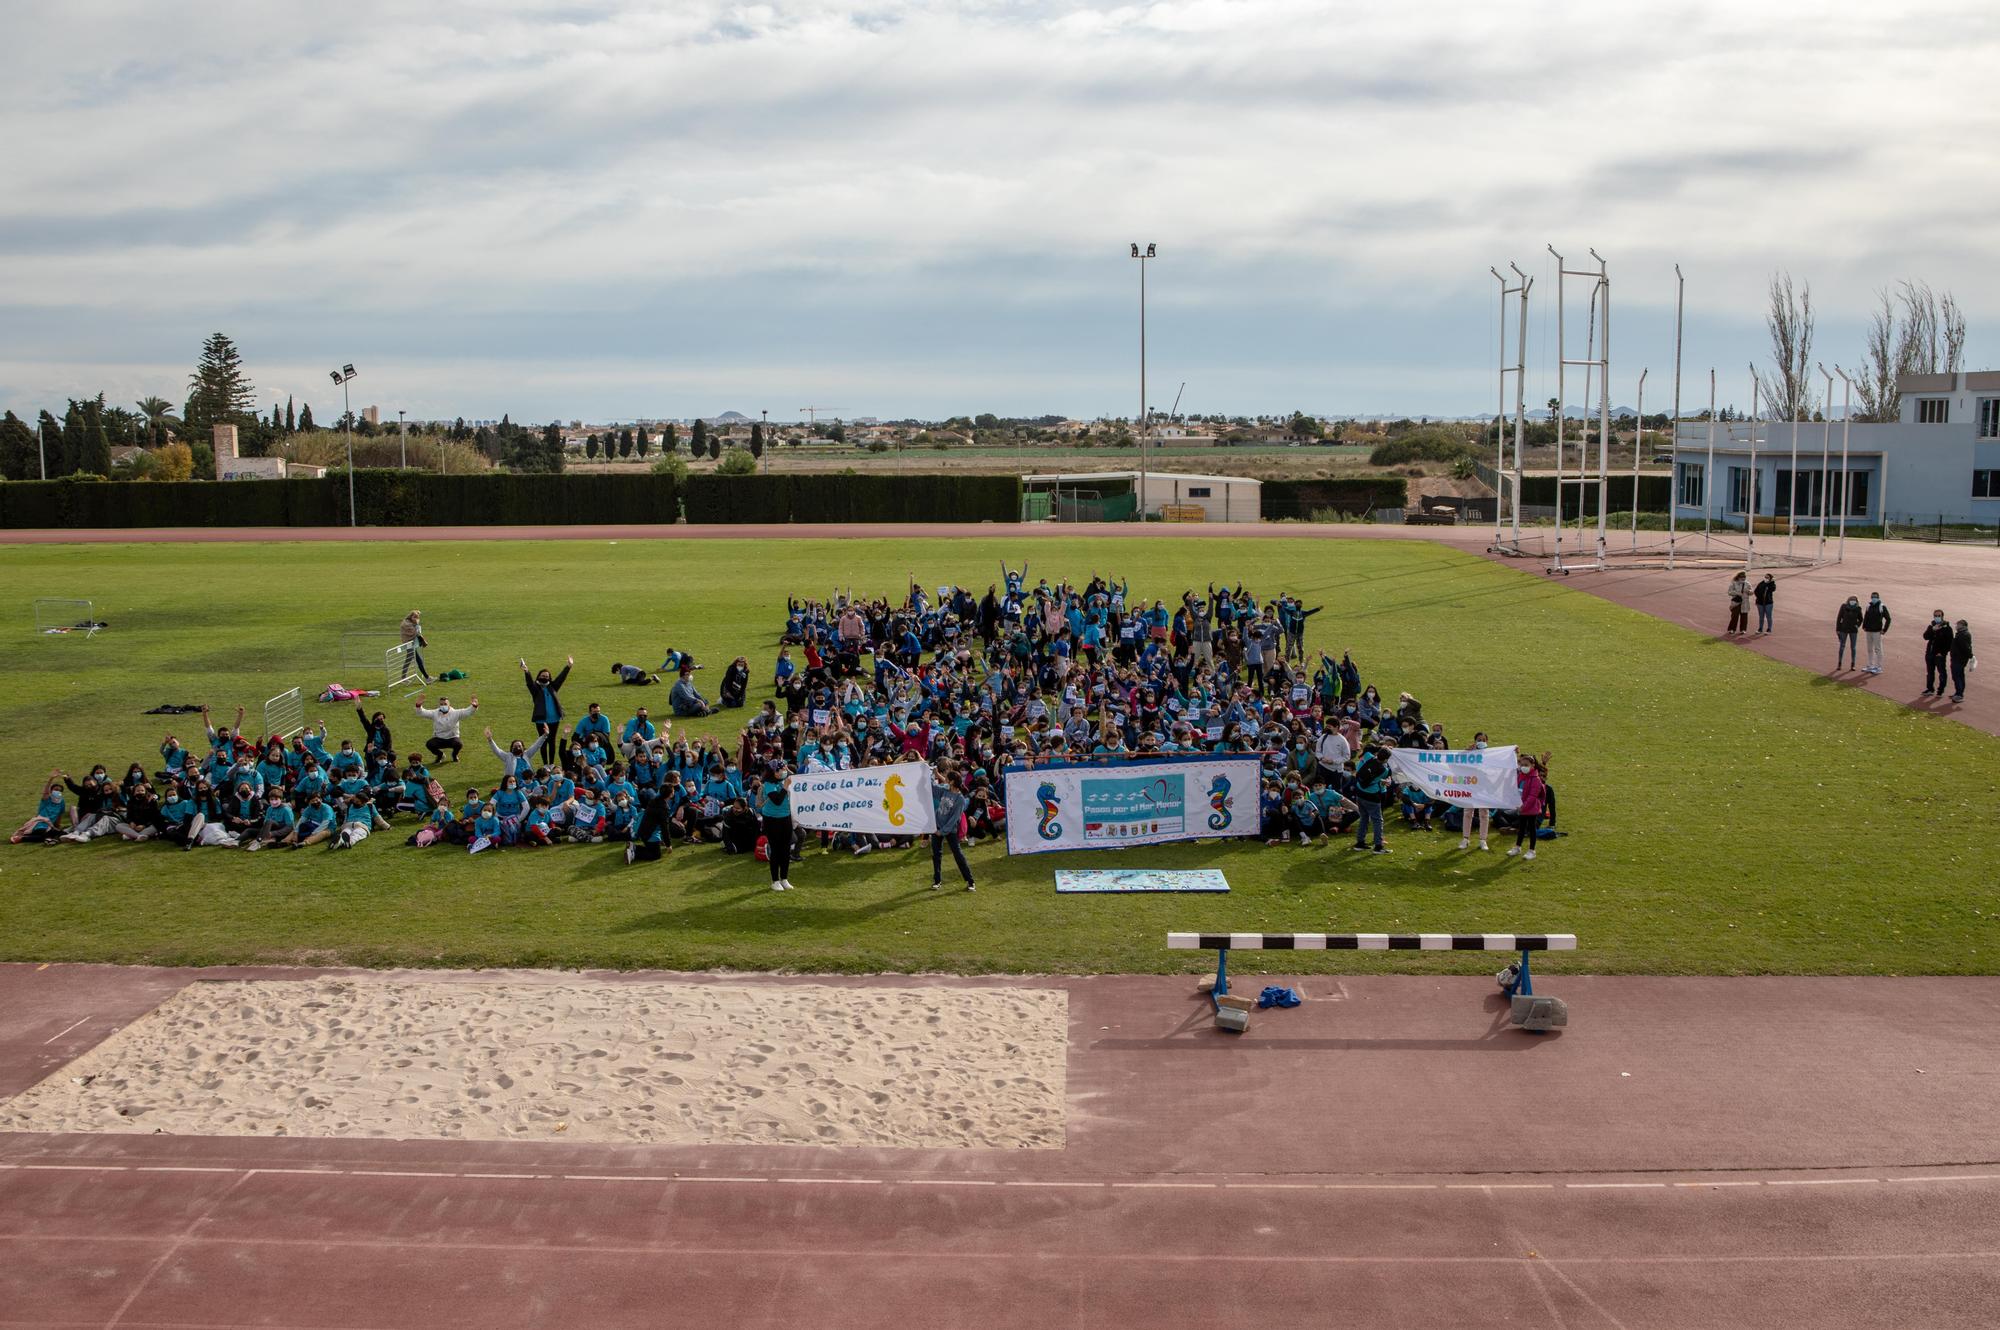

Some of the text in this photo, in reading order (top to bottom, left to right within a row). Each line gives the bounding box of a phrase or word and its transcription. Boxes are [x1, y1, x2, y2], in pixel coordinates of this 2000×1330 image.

[1419, 753, 1482, 764] MAR MENOR
[793, 782, 808, 792] El
[812, 782, 836, 791] cole
[797, 799, 873, 814] por los peces
[1113, 806, 1128, 815] por
[1130, 804, 1138, 812] el
